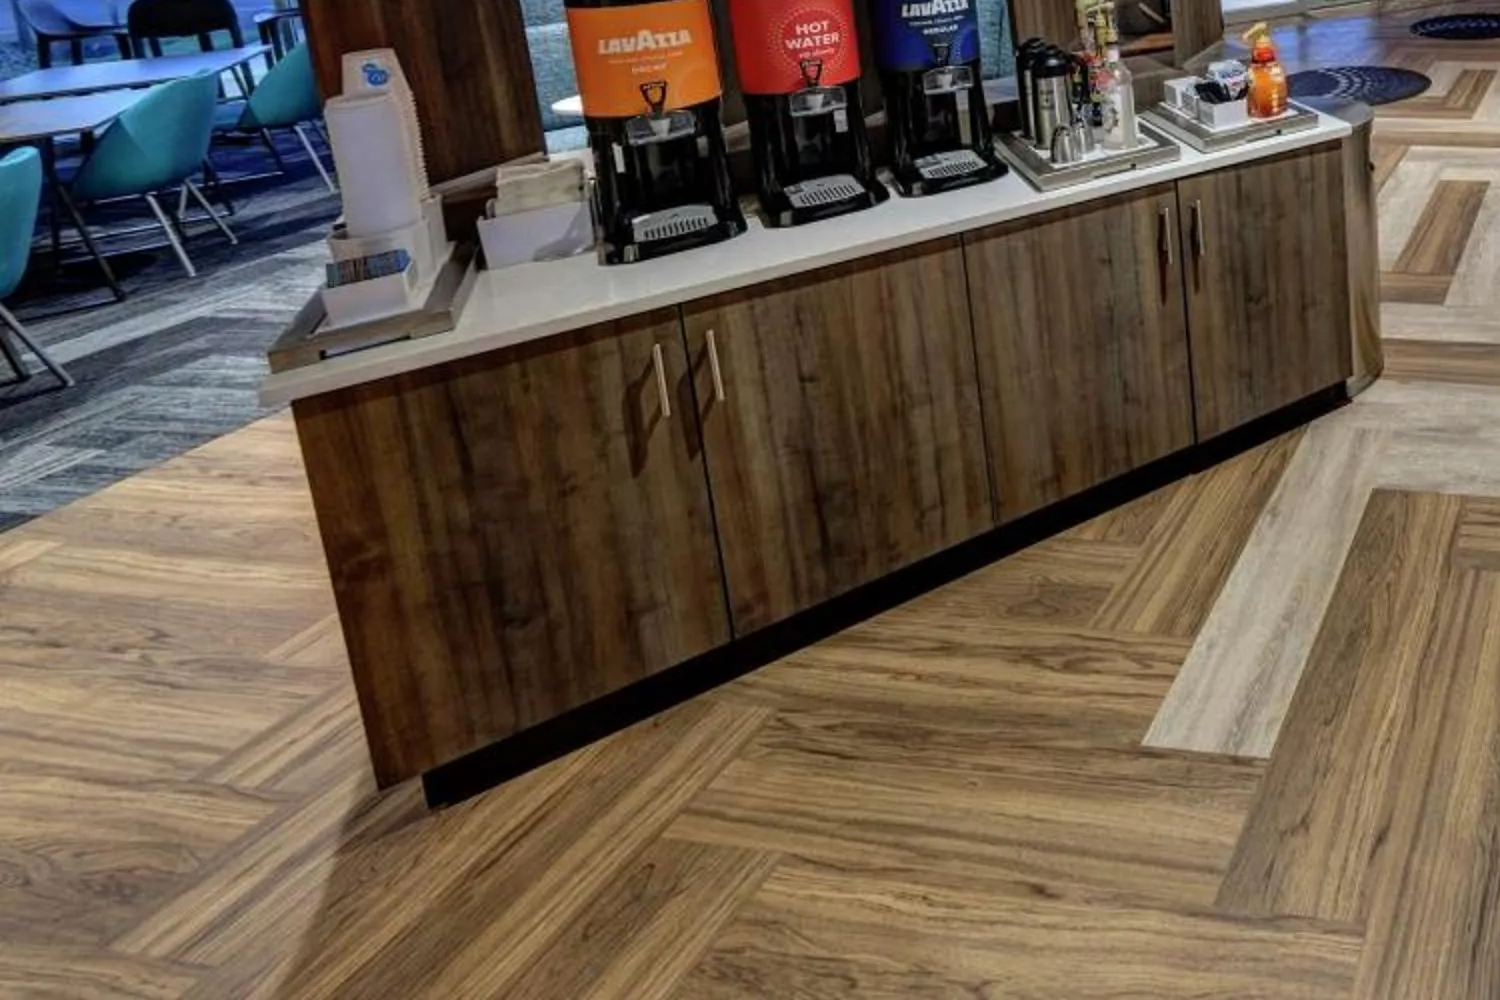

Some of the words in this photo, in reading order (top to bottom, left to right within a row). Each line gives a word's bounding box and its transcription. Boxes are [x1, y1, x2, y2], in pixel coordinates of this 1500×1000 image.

[795, 20, 830, 35] HOT
[598, 29, 692, 55] LAVAZZA
[785, 31, 840, 50] WATER
